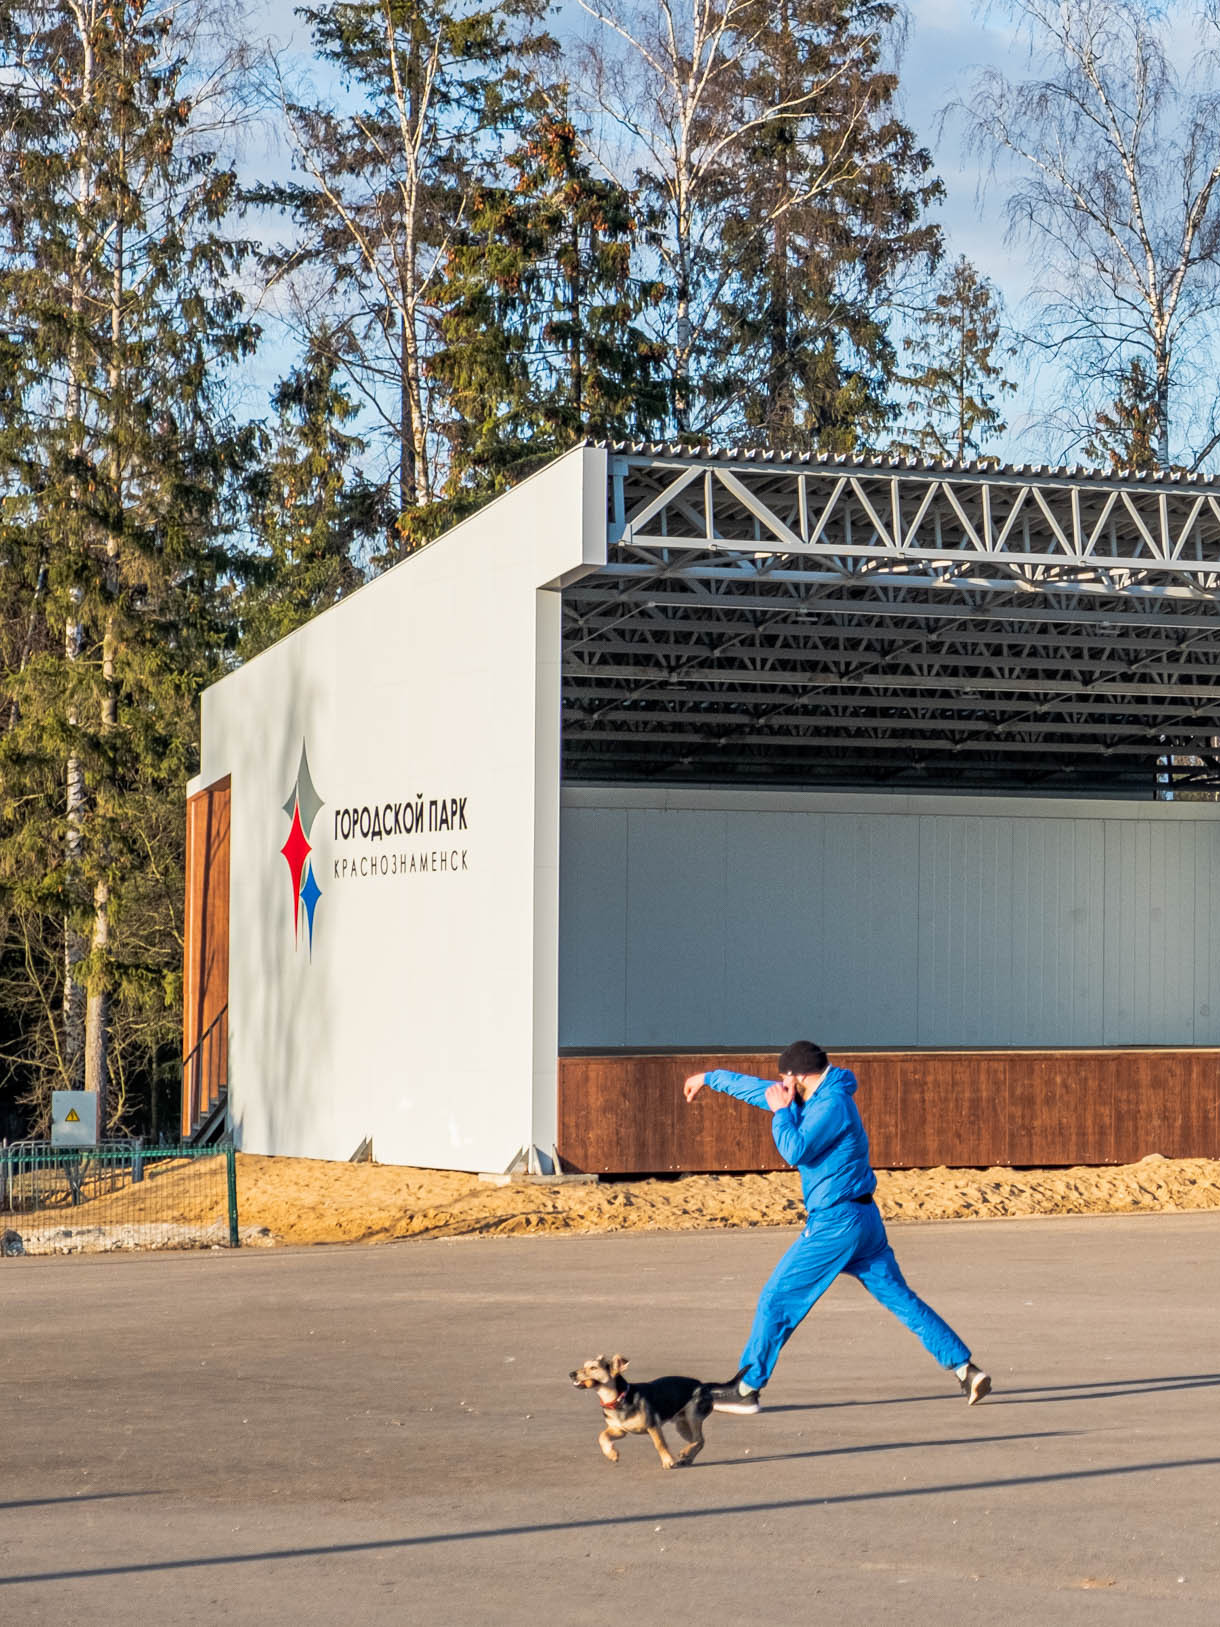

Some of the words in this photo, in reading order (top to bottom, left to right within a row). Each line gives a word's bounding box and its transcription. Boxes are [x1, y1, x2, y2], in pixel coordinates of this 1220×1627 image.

[334, 793, 424, 841] ГОРОДСКОЙ
[428, 797, 468, 832] ПАРК
[334, 849, 468, 879] КРАСНОЗНАМЕНСК
